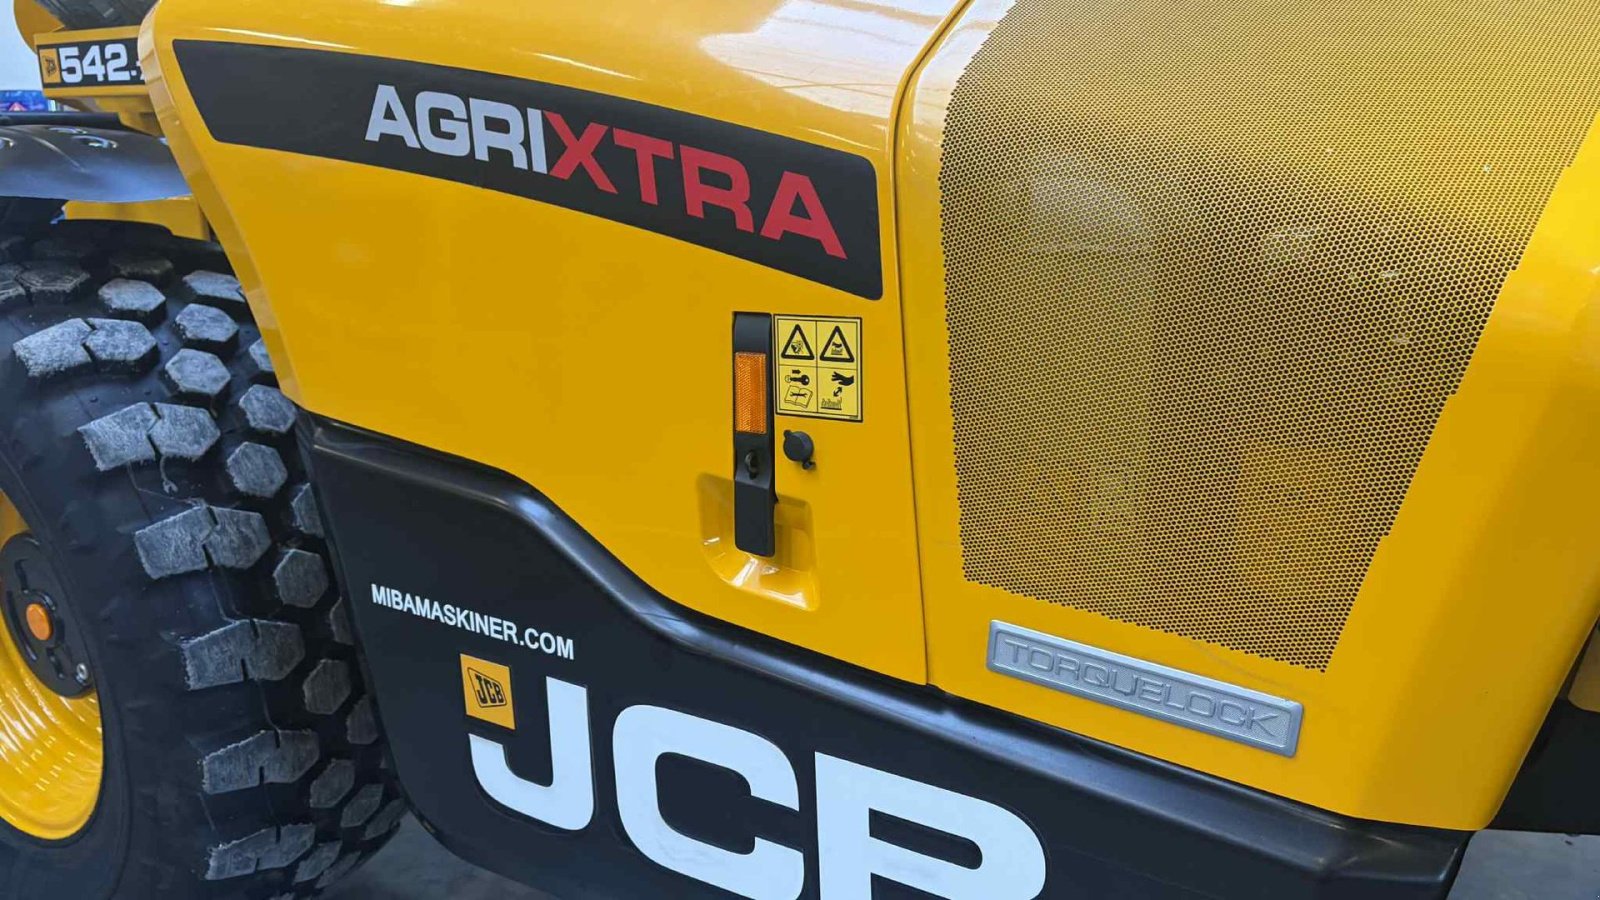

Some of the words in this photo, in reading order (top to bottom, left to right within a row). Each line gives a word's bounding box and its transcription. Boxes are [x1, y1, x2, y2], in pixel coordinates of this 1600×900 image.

[59, 43, 145, 83] 542.
[365, 84, 847, 259] AGRIXTRA
[371, 583, 575, 660] MIBAMASKINER.COM
[474, 673, 505, 705] JCB
[1004, 639, 1280, 738] TORQUELOCK
